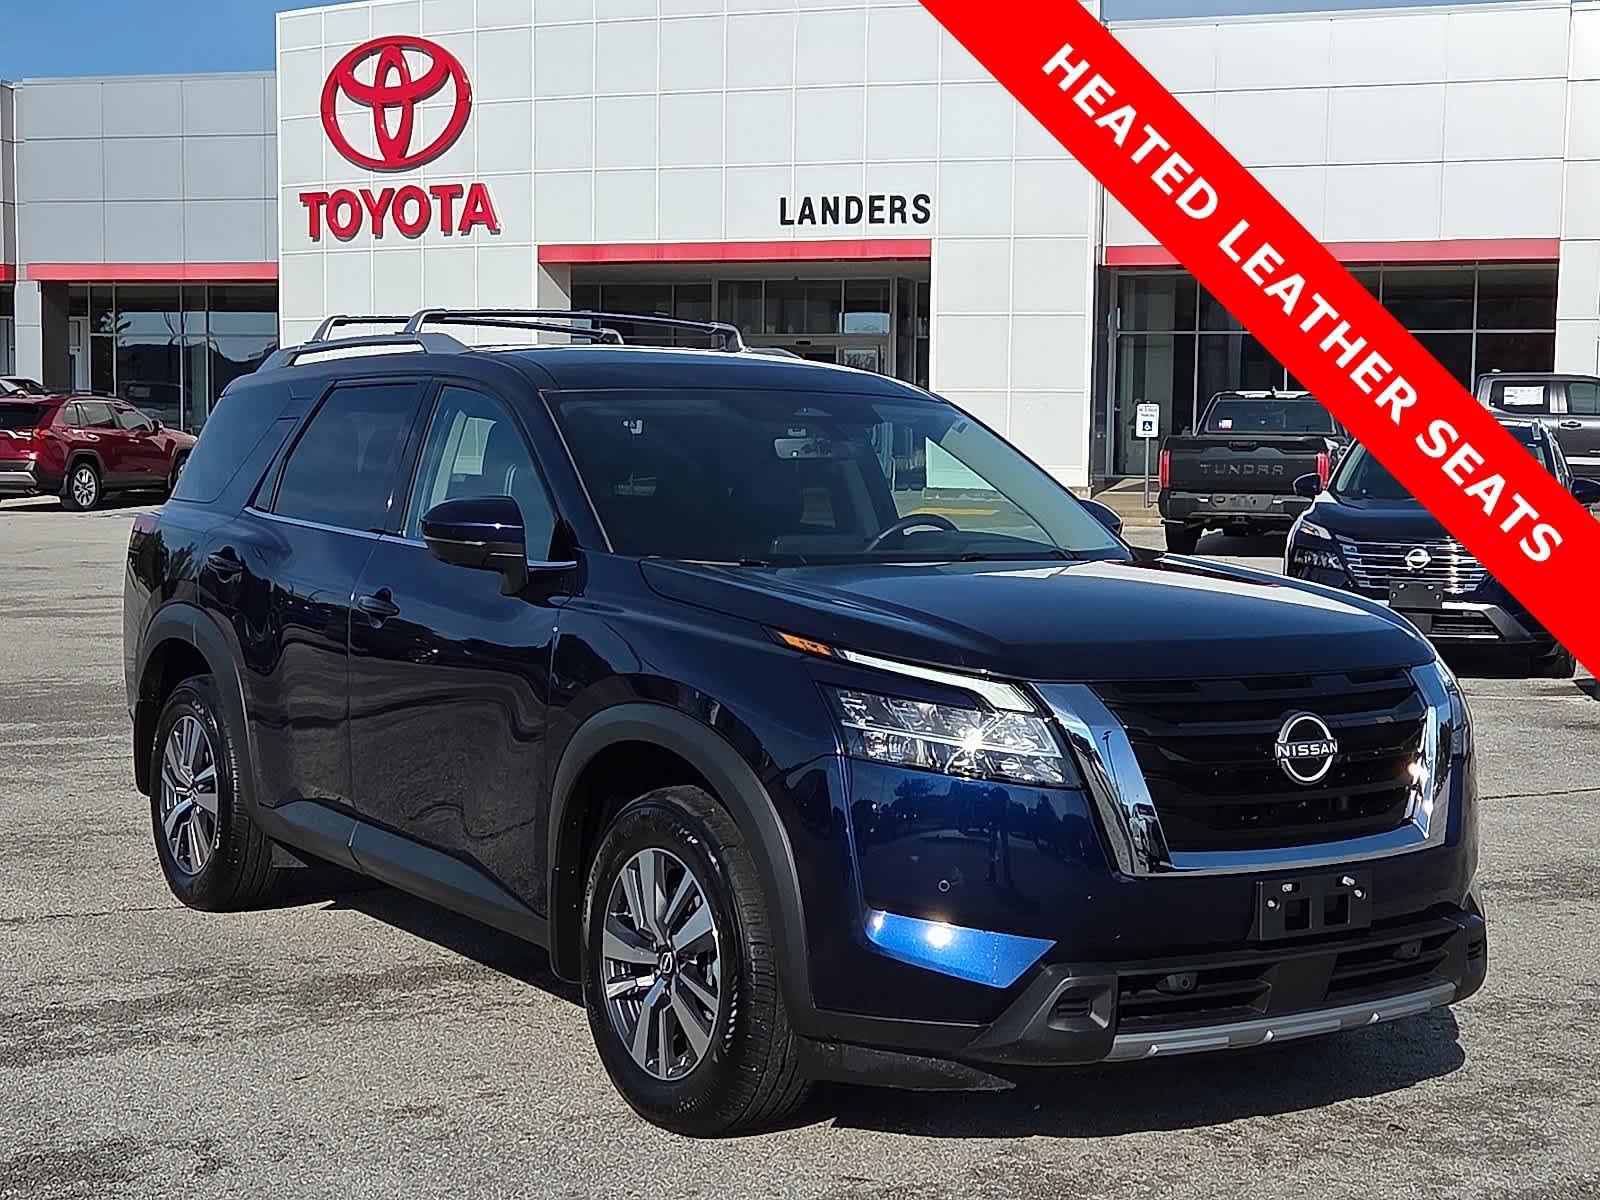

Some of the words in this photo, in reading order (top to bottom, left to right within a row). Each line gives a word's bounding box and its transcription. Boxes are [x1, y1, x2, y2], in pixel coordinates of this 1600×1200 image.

[299, 183, 500, 241] TOYOTA
[780, 193, 931, 225] LANDERS
[1200, 463, 1284, 476] TUNDRA
[1277, 741, 1338, 757] NISSAN
